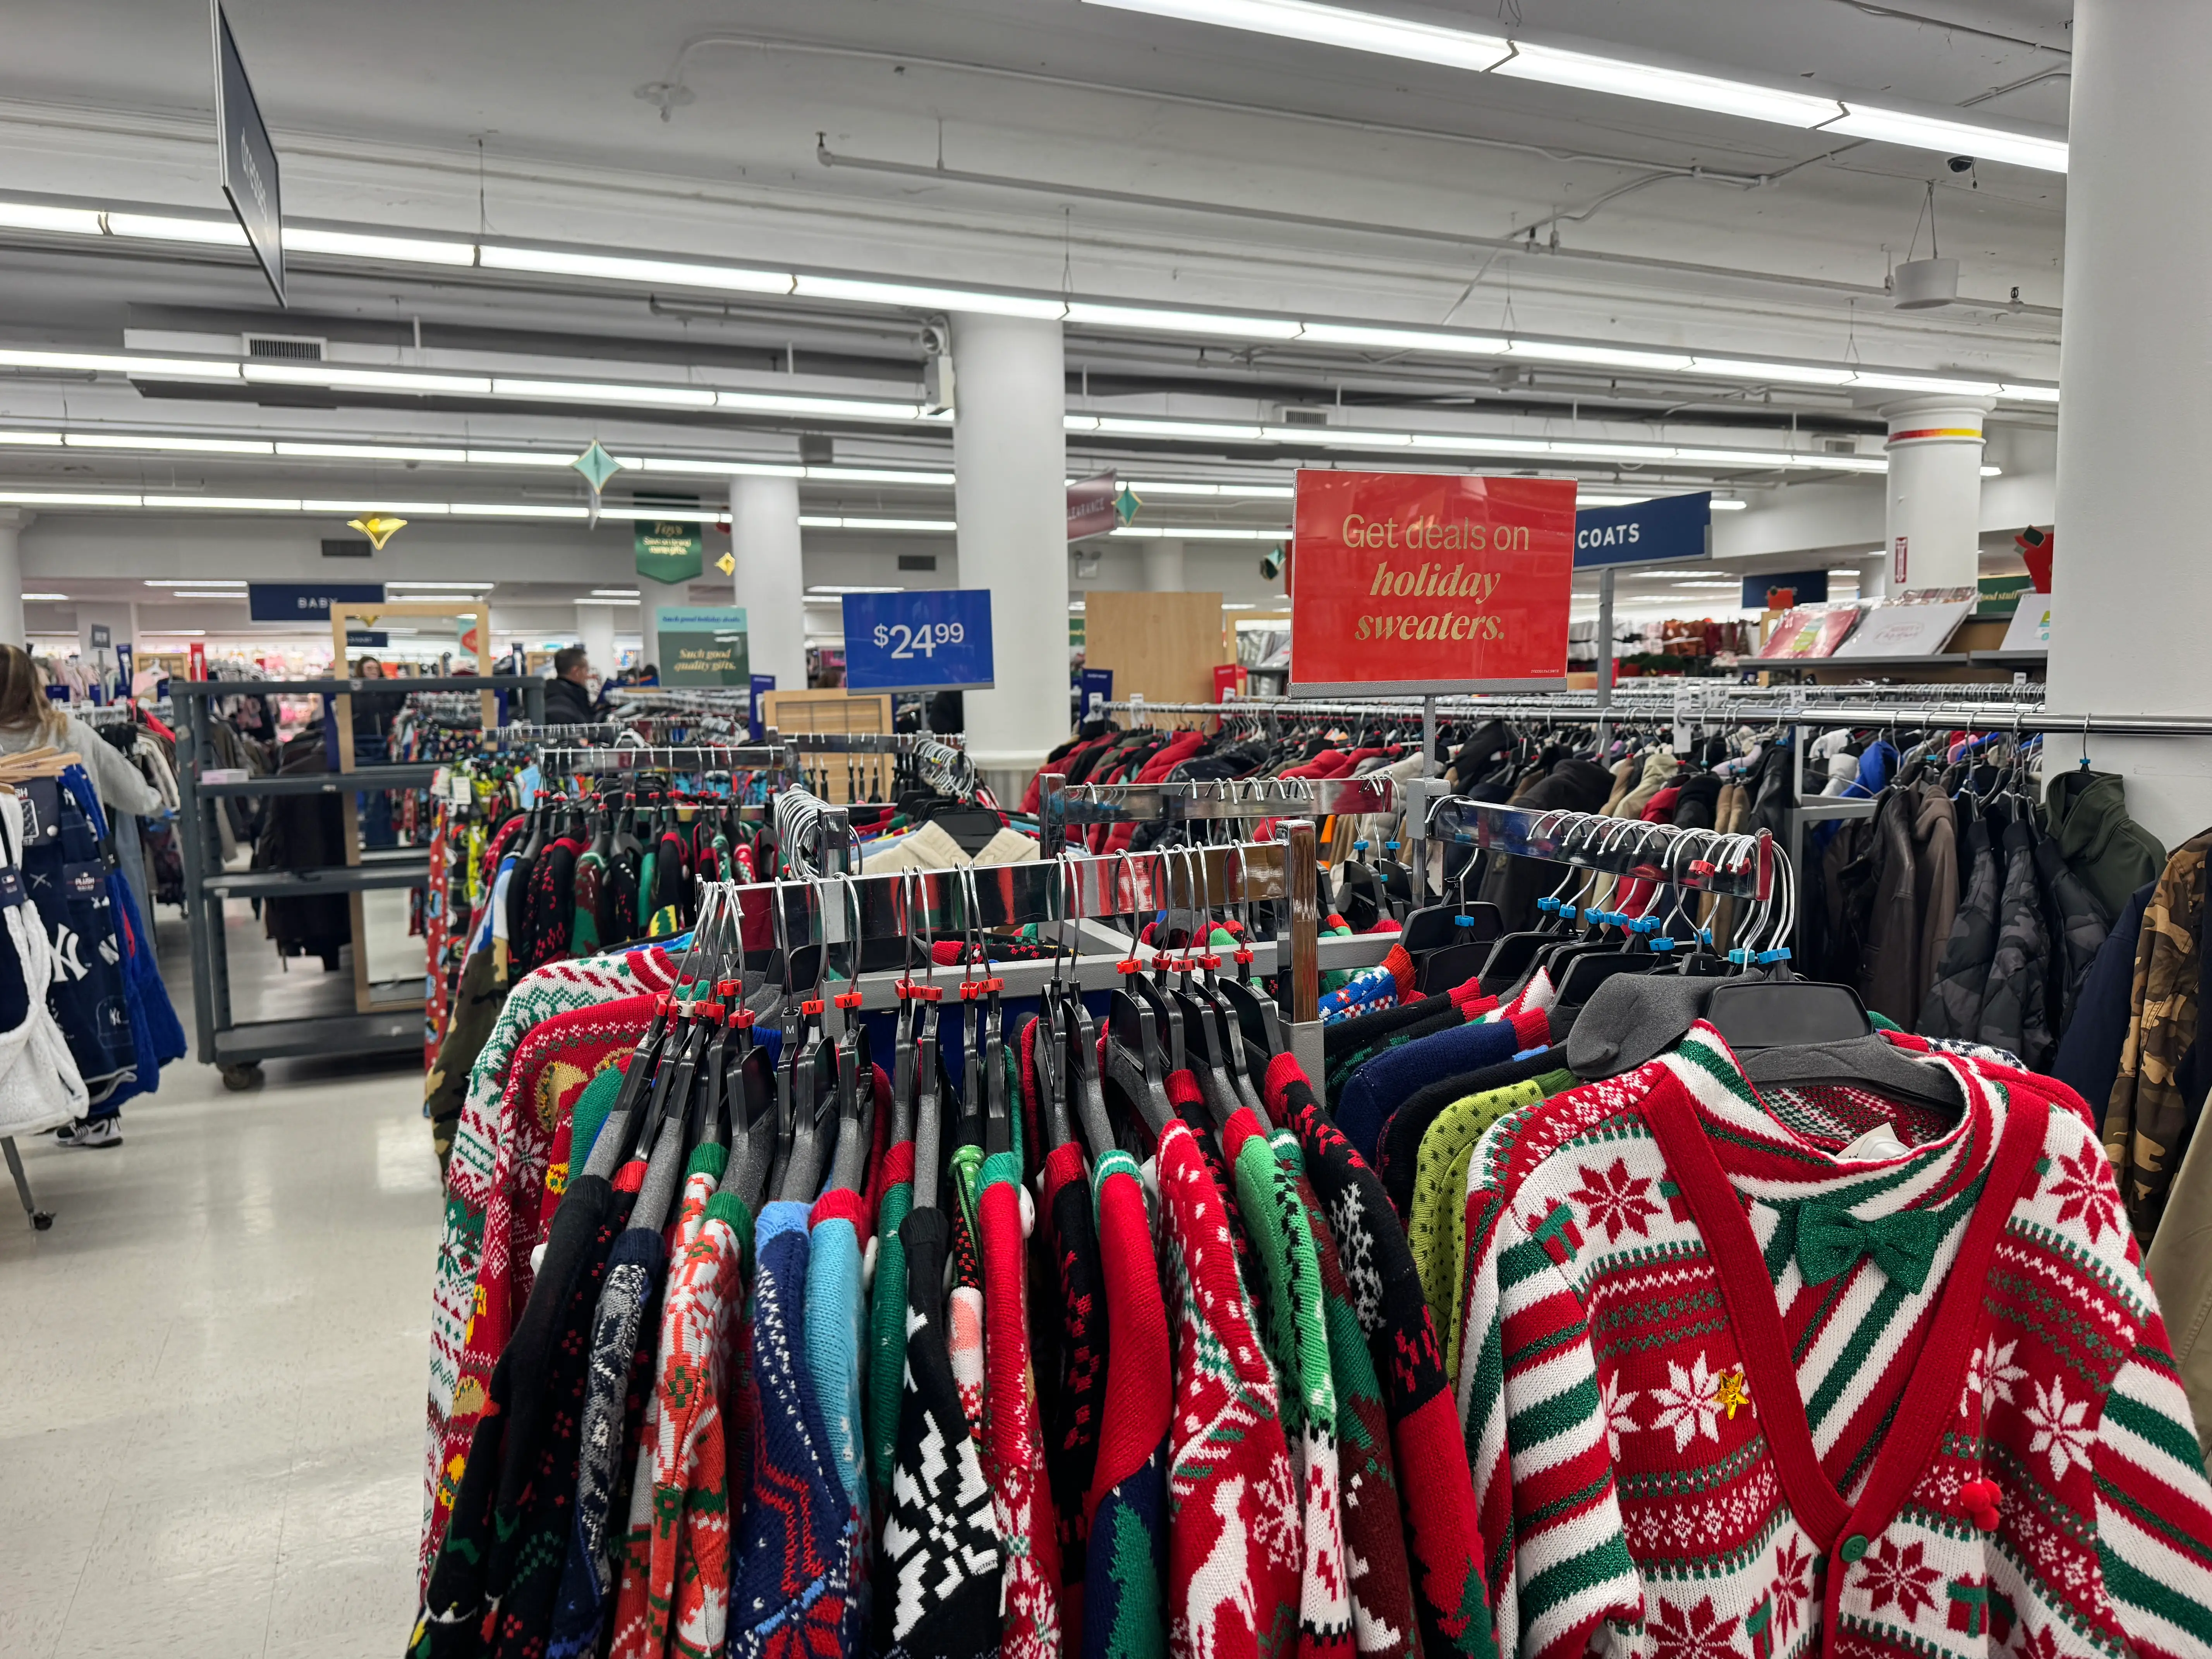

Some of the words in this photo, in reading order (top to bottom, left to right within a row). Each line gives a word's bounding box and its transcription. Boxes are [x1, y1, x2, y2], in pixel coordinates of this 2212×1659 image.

[241, 127, 267, 222] dresses
[1067, 497, 1105, 520] LEARANCE
[1343, 514, 1399, 548] Get
[1406, 515, 1486, 550] deals
[1494, 526, 1529, 550] on
[1578, 523, 1640, 549] COATS
[1369, 562, 1501, 604] holiday
[1355, 611, 1504, 641] sweaters.
[679, 648, 705, 659] Such
[706, 648, 731, 660] good
[674, 659, 709, 672] quality
[711, 659, 736, 672] gifts.
[75, 877, 94, 885] PLUSH
[1700, 960, 1706, 970] L
[733, 983, 739, 992] M
[808, 1003, 816, 1012] M
[844, 998, 852, 1007] M
[677, 1005, 683, 1014] S
[700, 1004, 708, 1013] M
[786, 1025, 794, 1034] M
